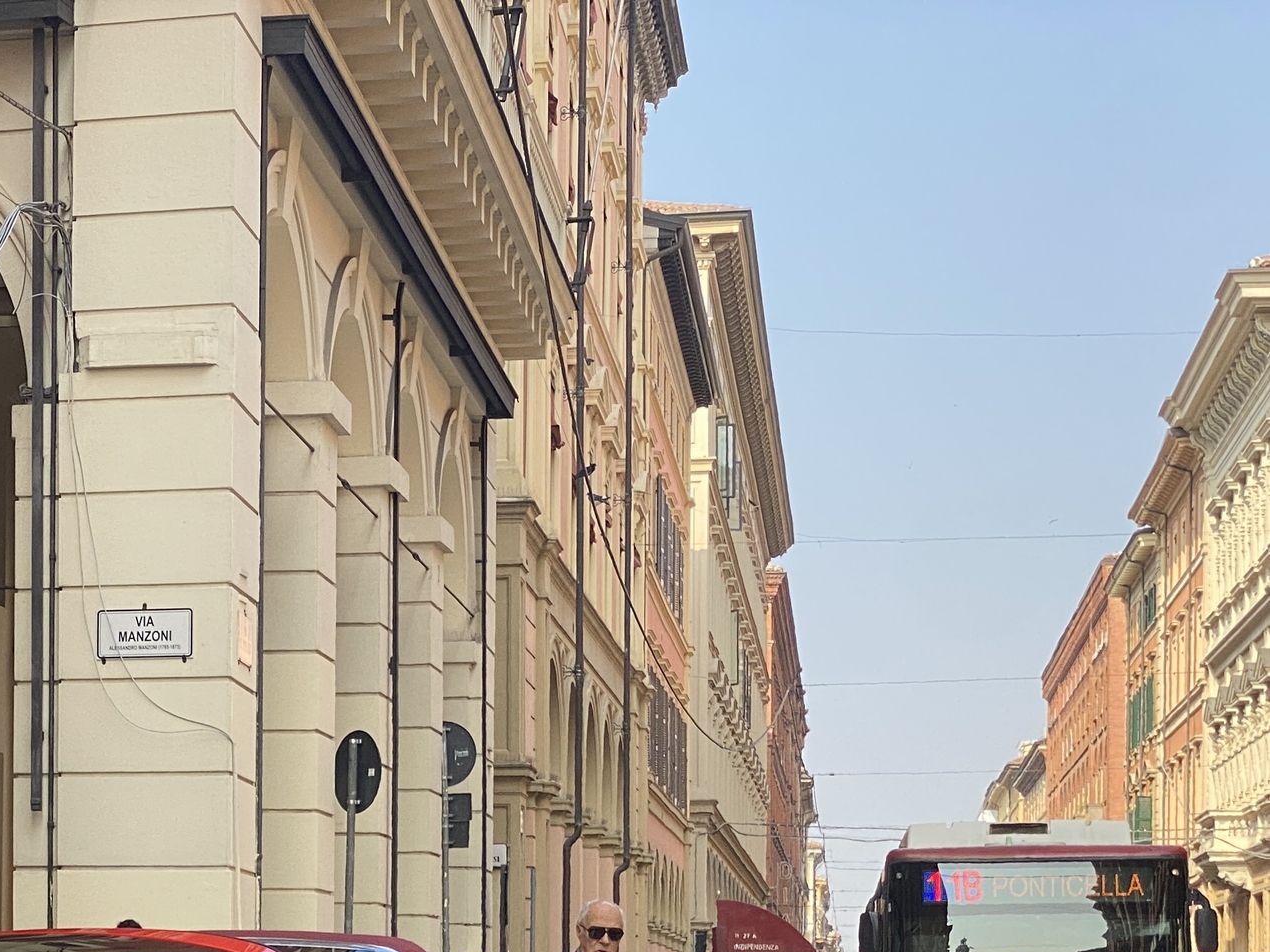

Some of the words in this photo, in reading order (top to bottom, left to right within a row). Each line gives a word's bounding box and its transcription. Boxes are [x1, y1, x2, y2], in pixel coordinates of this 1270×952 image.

[135, 616, 155, 627] VIA
[118, 630, 172, 642] MANZONI
[993, 873, 1145, 898] PONTICELLA
[733, 943, 779, 951] INDIPENDENZA
